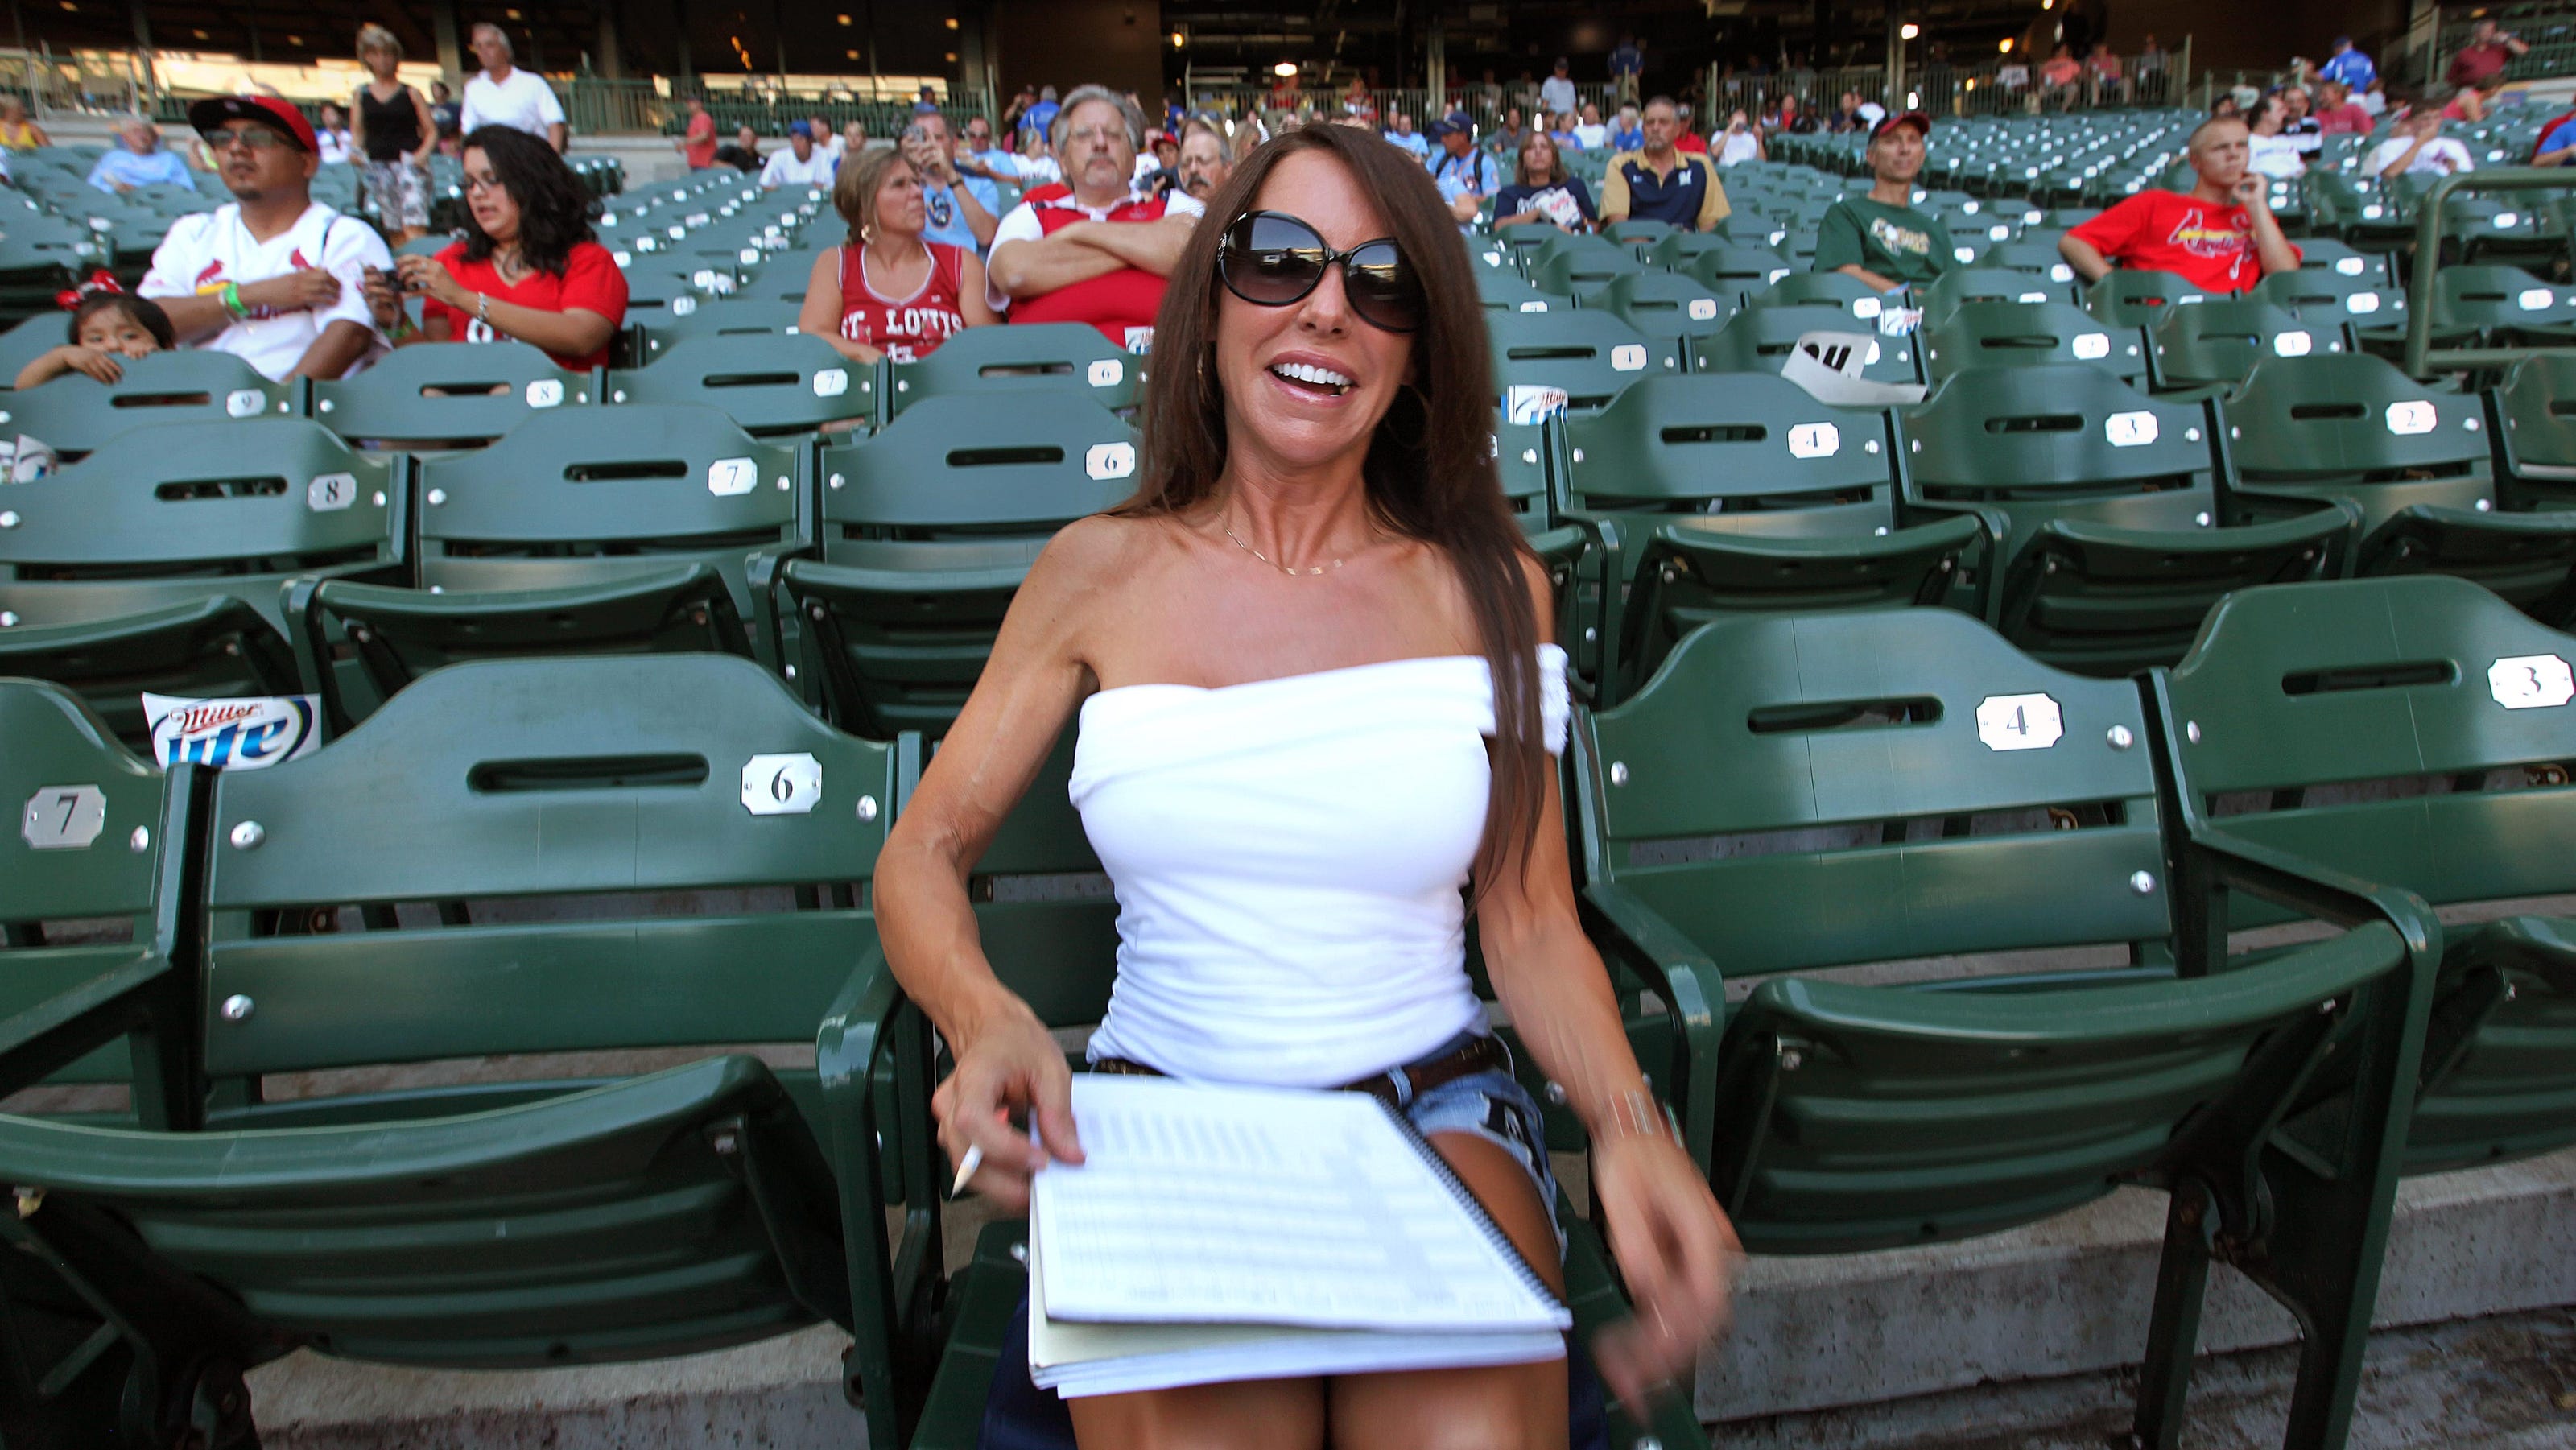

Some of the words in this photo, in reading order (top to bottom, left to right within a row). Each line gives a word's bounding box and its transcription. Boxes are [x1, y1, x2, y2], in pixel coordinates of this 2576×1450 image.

[827, 374, 835, 390] 7
[1101, 366, 1110, 381] 6
[540, 386, 550, 400] 8
[2124, 418, 2138, 440] 3
[2406, 409, 2418, 427] 2
[1104, 449, 1118, 473] 6
[726, 465, 739, 487] 7
[325, 478, 340, 504] 8
[2520, 666, 2542, 698] 3
[170, 701, 258, 733] Miller
[2005, 704, 2029, 736] 4
[770, 762, 794, 804] 6
[56, 794, 80, 835] 7
